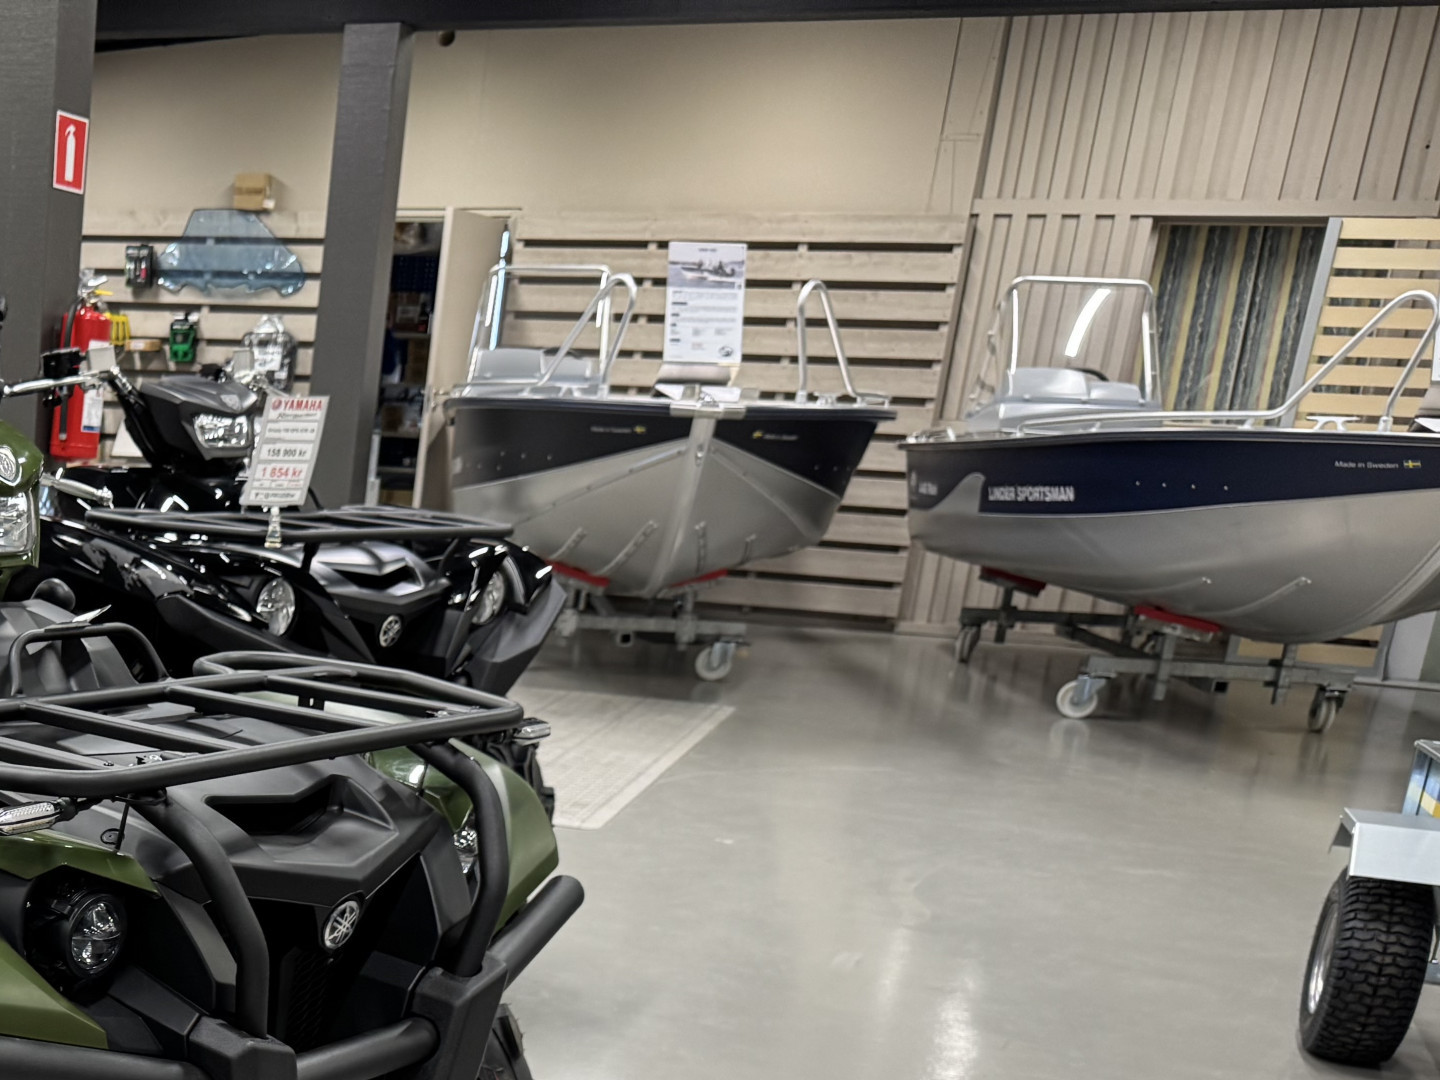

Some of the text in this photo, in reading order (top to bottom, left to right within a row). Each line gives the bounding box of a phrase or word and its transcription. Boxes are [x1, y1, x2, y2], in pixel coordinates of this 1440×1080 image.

[283, 399, 322, 411] YAMAHA
[282, 448, 296, 457] 900
[291, 467, 302, 477] kr
[1017, 486, 1075, 502] SPORTSMAN
